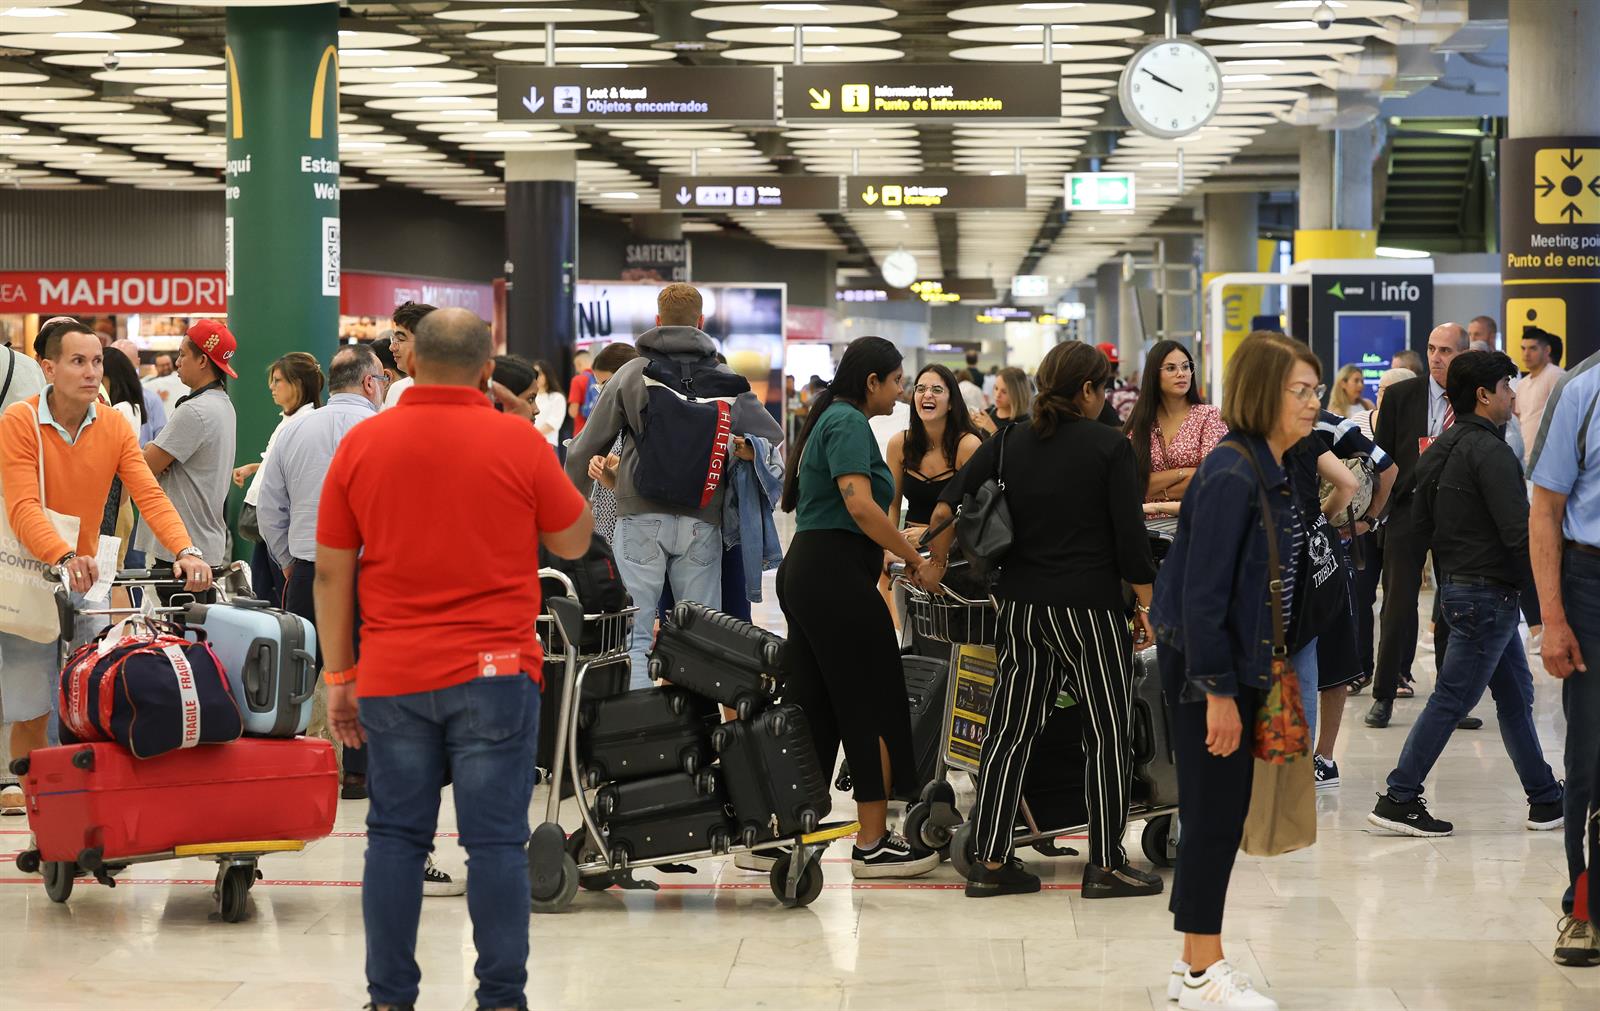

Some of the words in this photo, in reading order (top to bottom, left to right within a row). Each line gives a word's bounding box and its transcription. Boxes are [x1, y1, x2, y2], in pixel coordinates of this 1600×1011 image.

[609, 87, 619, 99] &
[586, 101, 632, 114] Objetos
[634, 100, 708, 113] encontrados
[874, 98, 910, 110] Punto
[912, 98, 928, 110] de
[1530, 233, 1579, 250] Meeting
[1507, 253, 1541, 268] Punto
[1544, 252, 1564, 267] de
[1381, 280, 1420, 301] info
[705, 411, 731, 491] HILFIGER
[171, 654, 193, 690] FRAGILE
[185, 700, 198, 742] FRAGILE
